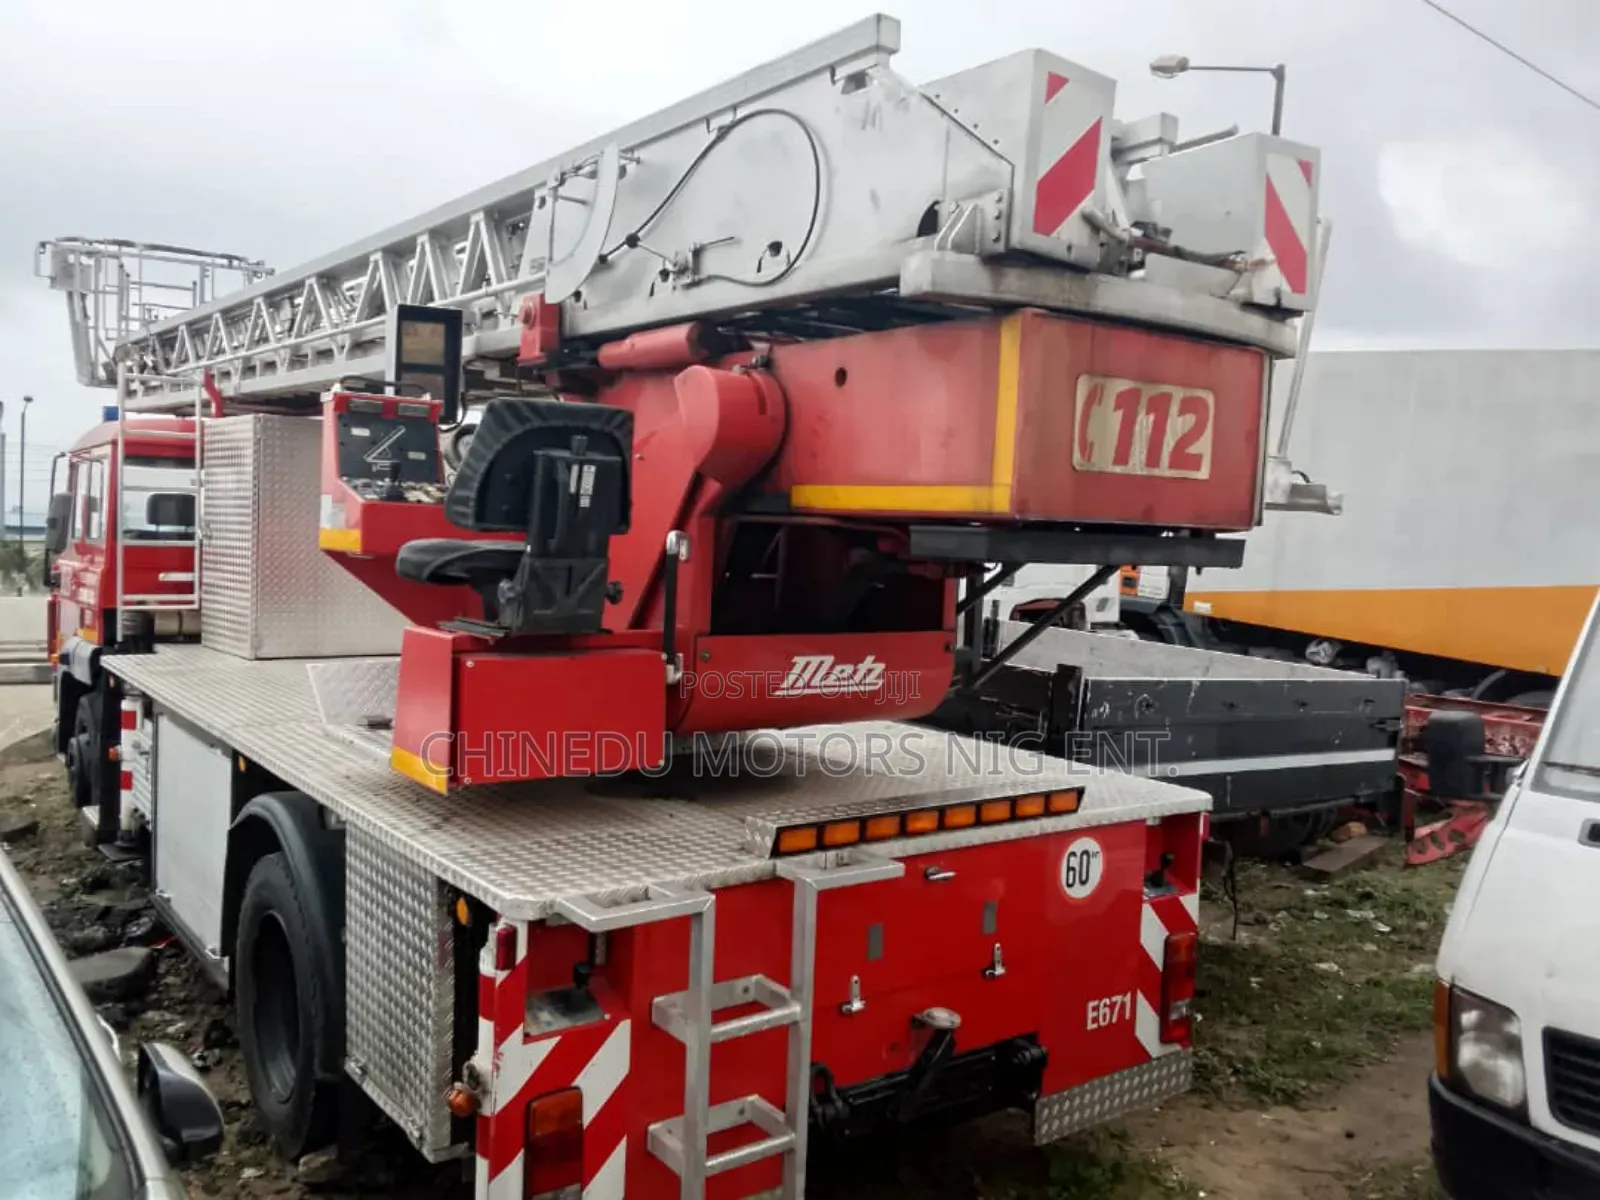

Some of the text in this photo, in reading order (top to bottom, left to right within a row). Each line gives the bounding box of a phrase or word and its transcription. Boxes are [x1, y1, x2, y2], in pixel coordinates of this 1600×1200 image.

[1112, 388, 1210, 471] 112
[774, 655, 886, 696] Metz
[1065, 849, 1091, 888] 60
[1086, 991, 1132, 1031] E671
